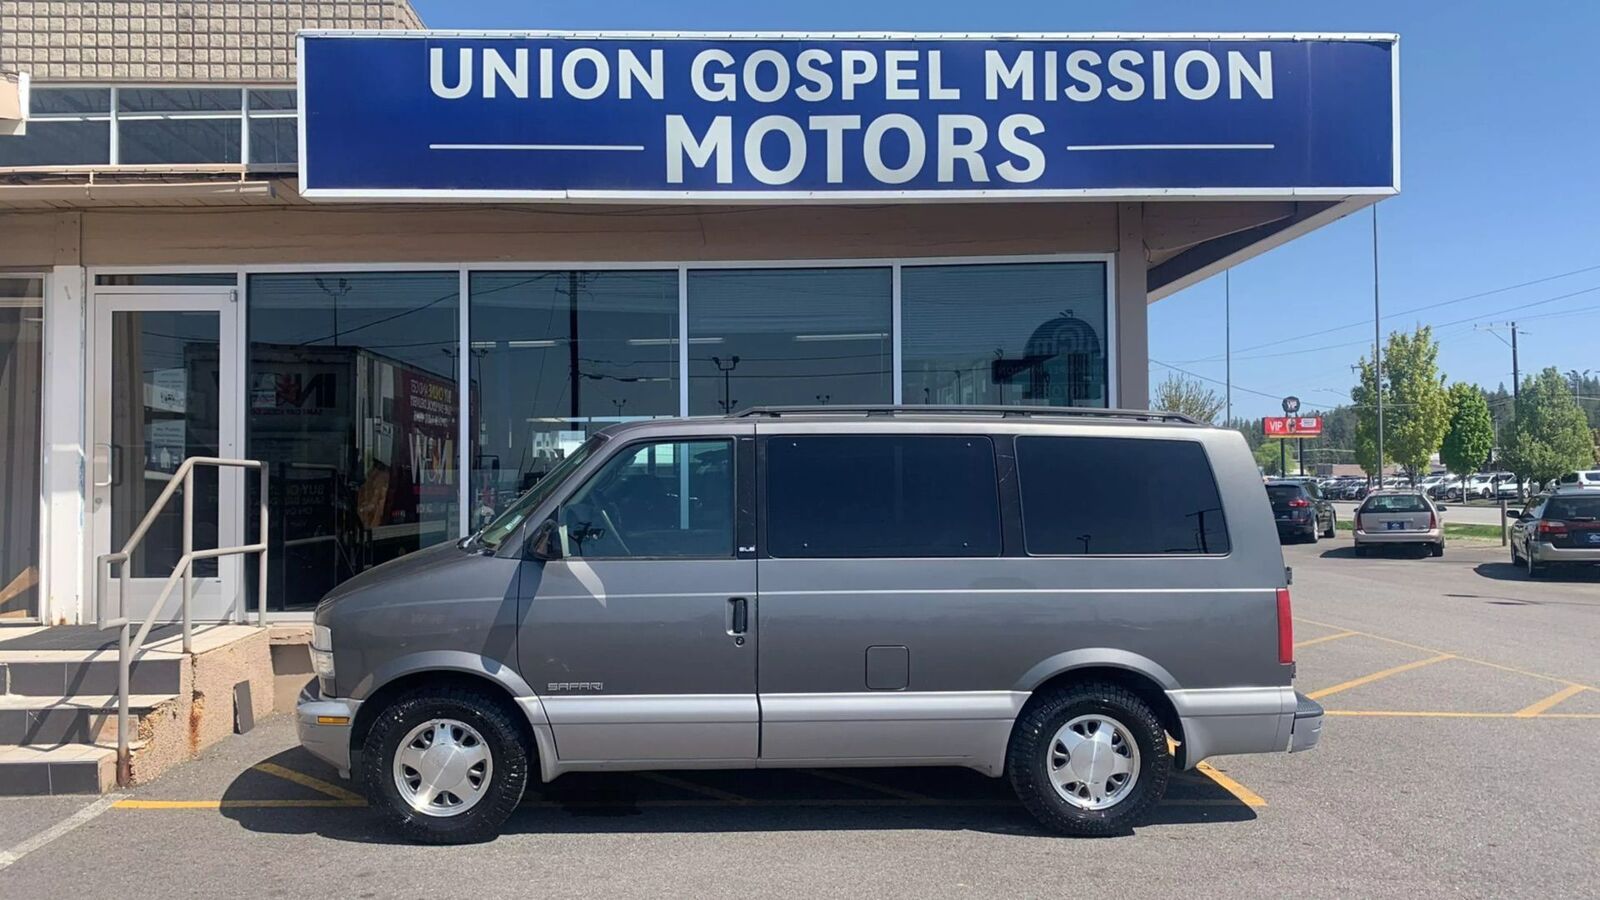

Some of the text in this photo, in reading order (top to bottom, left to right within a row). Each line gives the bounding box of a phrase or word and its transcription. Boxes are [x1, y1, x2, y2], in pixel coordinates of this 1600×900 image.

[431, 48, 1273, 102] UNION GOSPEL MISSION
[666, 114, 1045, 184] MOTORS
[1287, 401, 1297, 409] VIP
[1269, 421, 1283, 432] VIP
[548, 682, 603, 691] SAFARI
